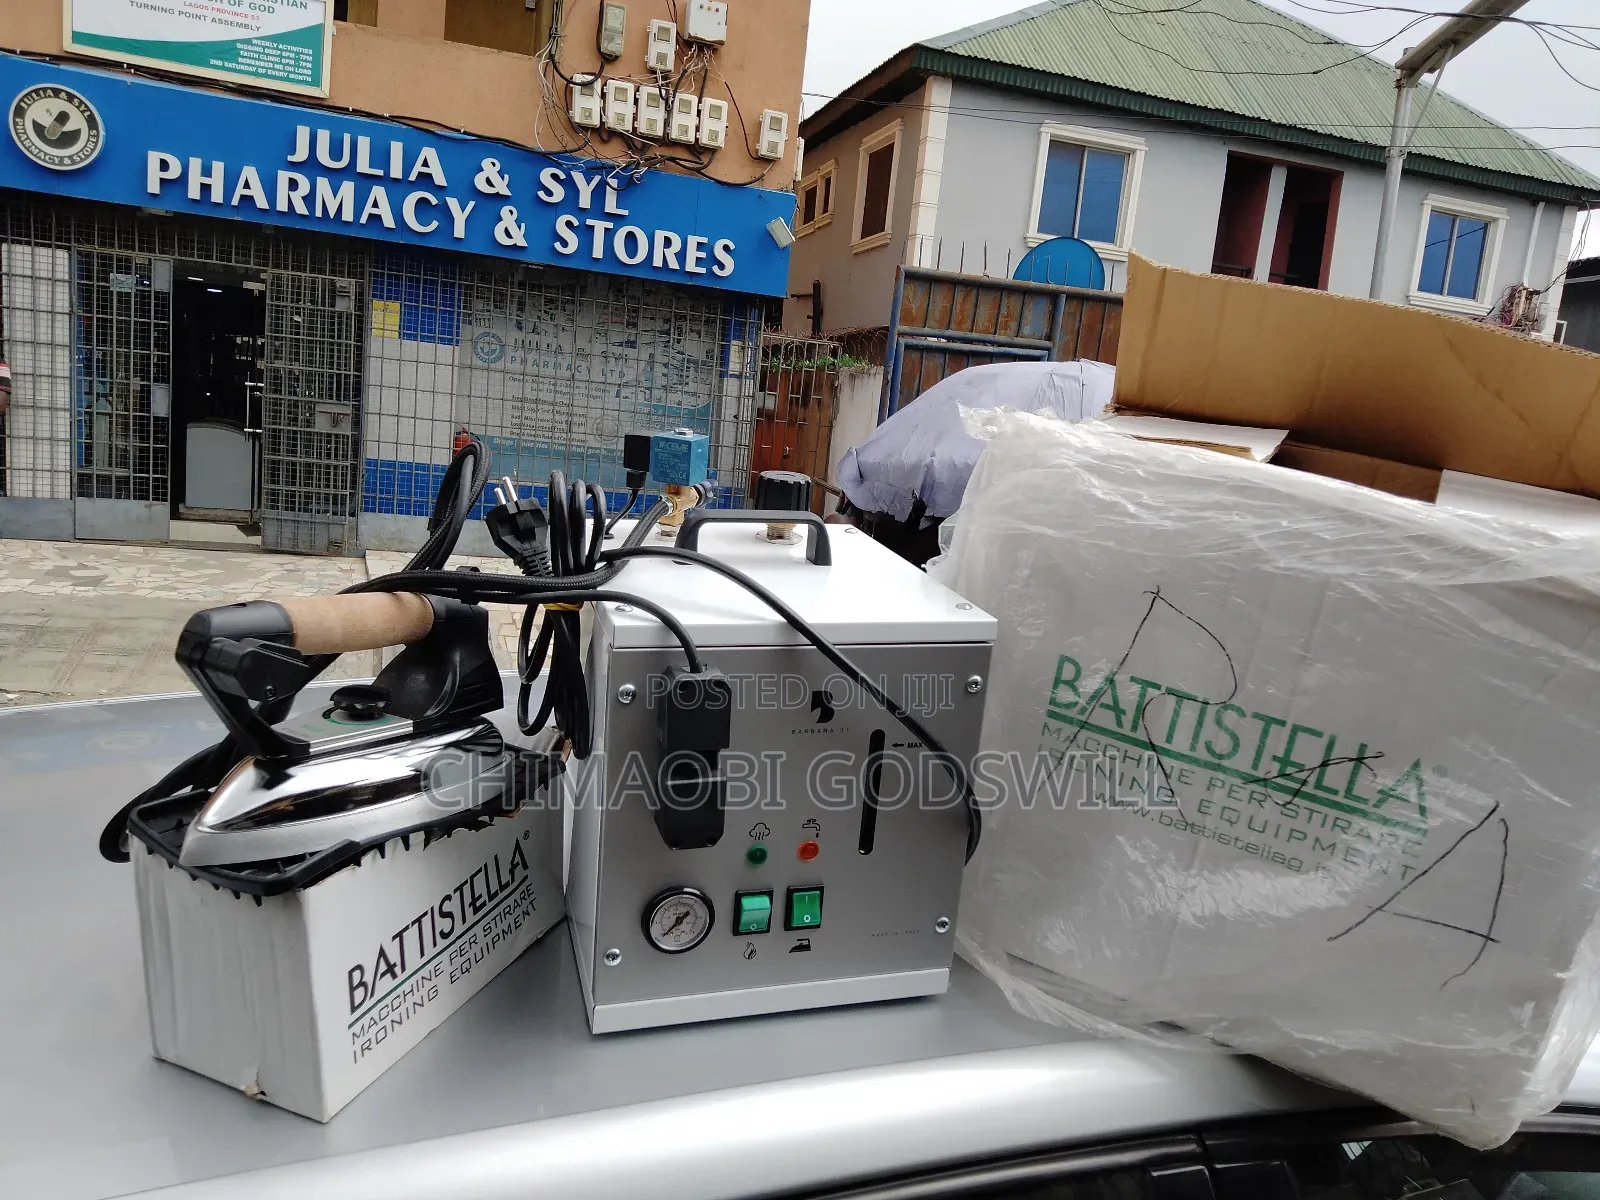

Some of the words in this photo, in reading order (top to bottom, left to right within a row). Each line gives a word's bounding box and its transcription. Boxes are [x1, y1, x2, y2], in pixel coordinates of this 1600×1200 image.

[129, 0, 175, 15] TURNING
[178, 10, 208, 22] POINT
[211, 17, 262, 32] ASSEMBLY
[183, 1, 209, 11] LAGOS
[211, 7, 249, 19] PROVINCE
[229, 0, 244, 8] OF
[249, 2, 276, 14] GOD
[240, 50, 259, 59] FAITH
[259, 54, 281, 63] CLINIC
[252, 38, 278, 48] WEEKLY
[279, 43, 313, 55] ACTIVITIES
[224, 61, 257, 73] SATURDAY
[267, 69, 289, 78] EVERY
[288, 73, 312, 82] MONTH
[238, 57, 273, 68] REMEMBER
[295, 67, 312, 75] LORD
[20, 89, 55, 110] JULIA
[59, 91, 68, 101] &
[71, 98, 92, 119] SYL
[15, 117, 61, 164] PHARMACY
[63, 157, 72, 165] &
[73, 129, 98, 162] STORES
[287, 125, 448, 187] JULIA
[474, 156, 512, 196] &
[537, 166, 630, 217] SYL
[146, 150, 476, 240] PHARMACY
[493, 205, 528, 247] &
[553, 214, 735, 277] STORES
[510, 356, 592, 378] PHARMACY
[601, 367, 626, 379] LTD
[1048, 654, 1429, 824] BATTISTELLA
[1206, 776, 1268, 810] PER
[1197, 798, 1420, 882] EQUIPMENT
[347, 836, 529, 1016] BATTISTELLA
[351, 960, 444, 1046] MACCHINE
[449, 932, 479, 966] PER
[483, 882, 534, 938] STIRARE
[353, 984, 439, 1065] IRONING
[450, 897, 537, 985] EQUIPMENT
